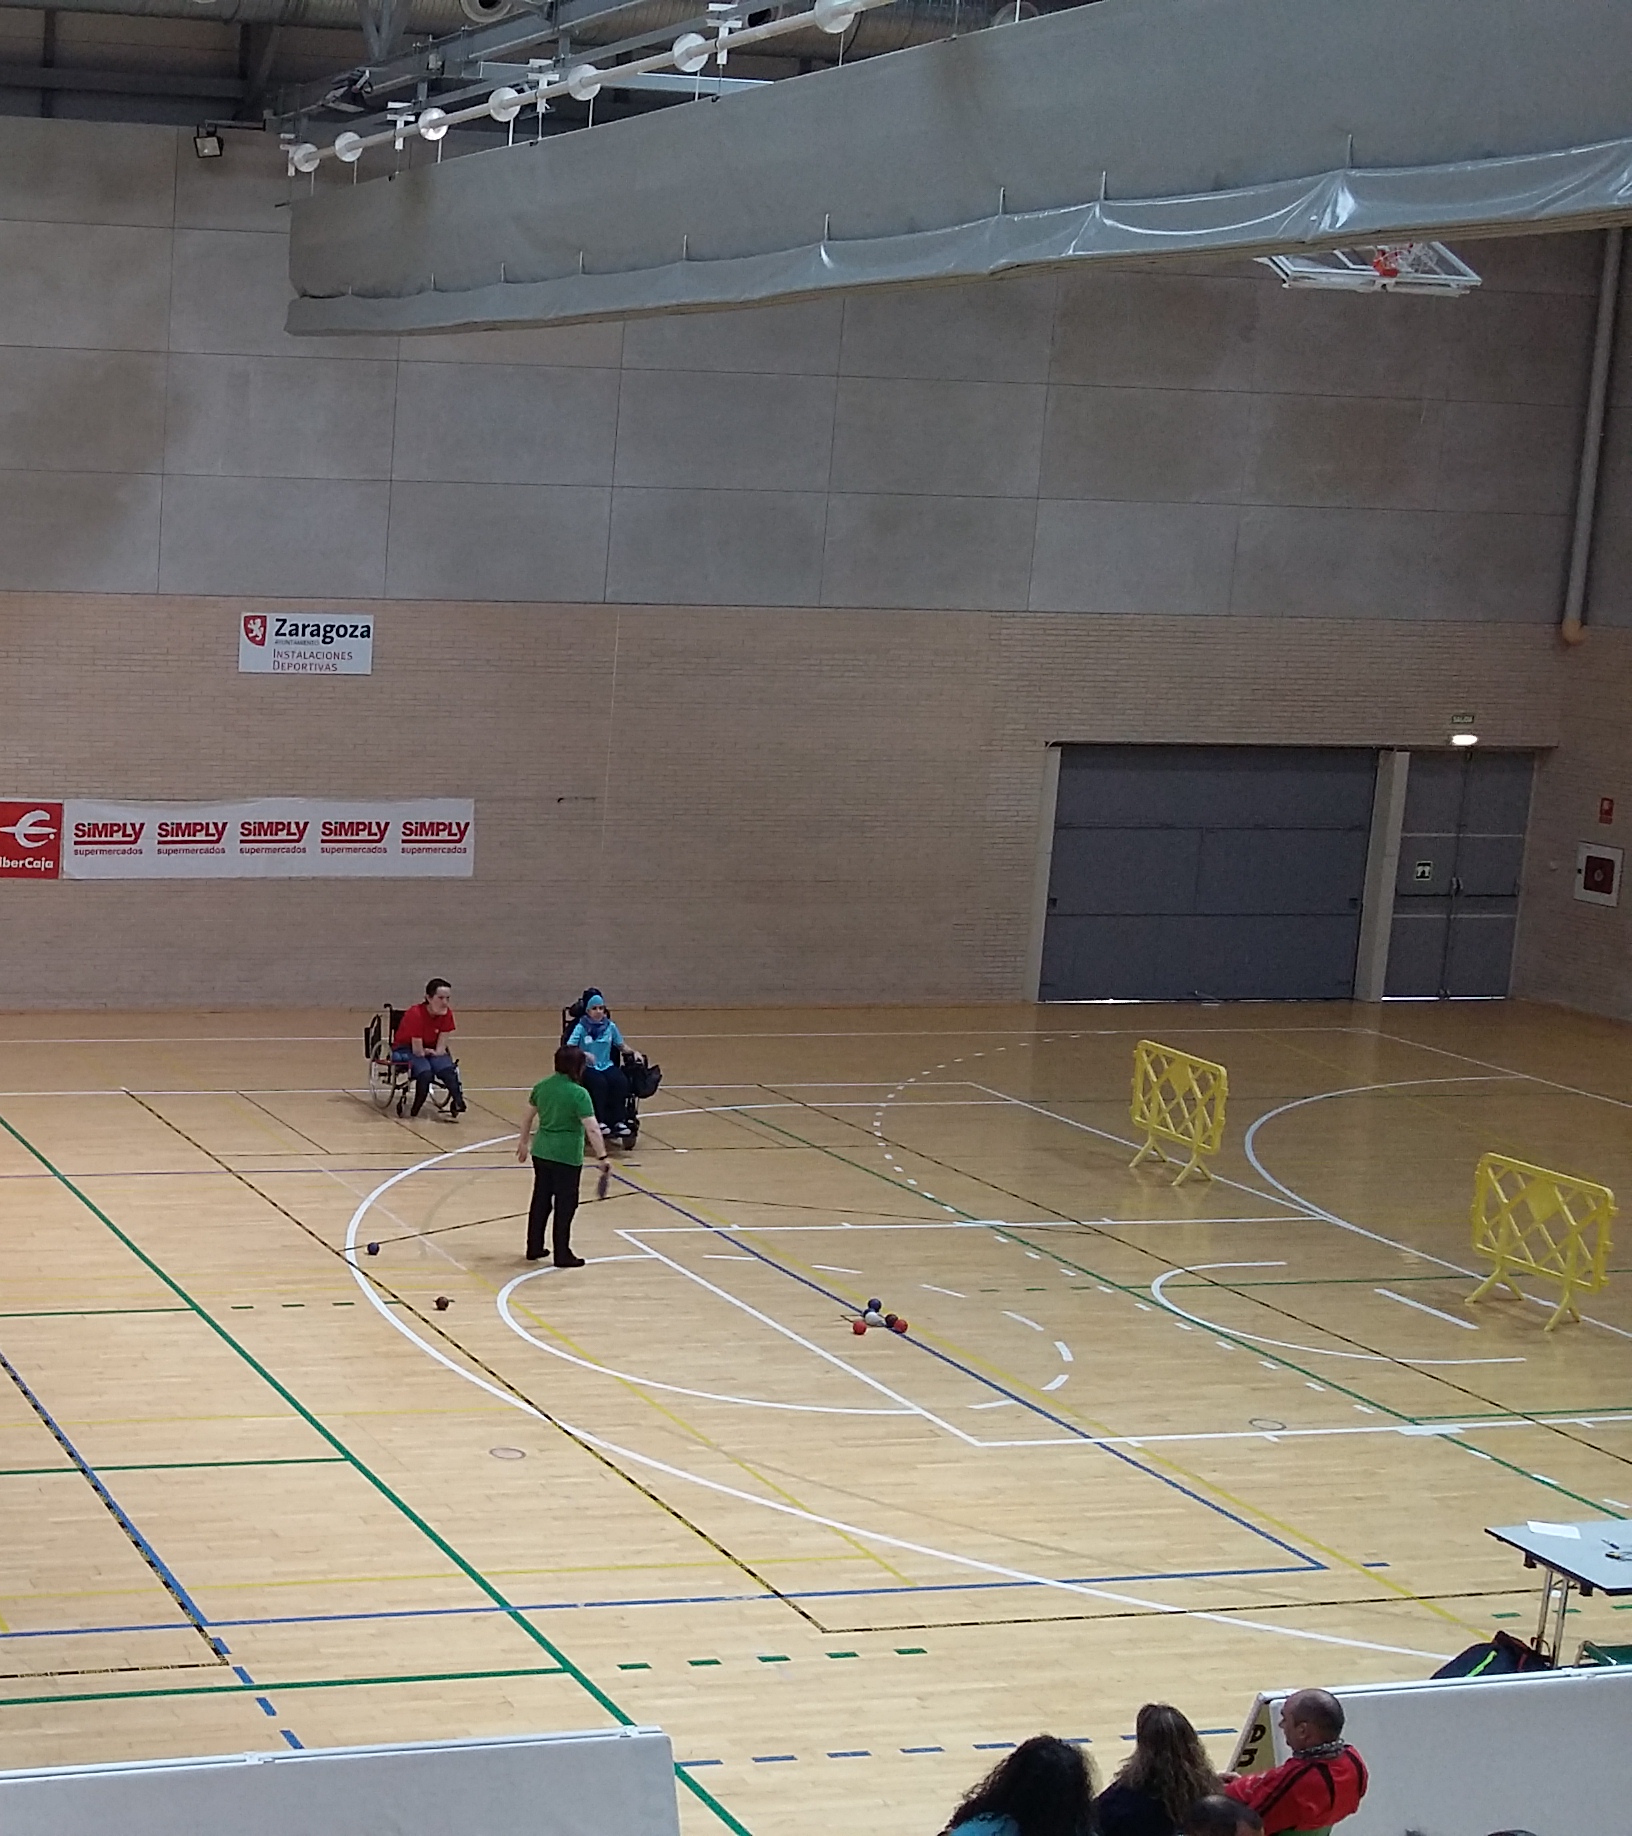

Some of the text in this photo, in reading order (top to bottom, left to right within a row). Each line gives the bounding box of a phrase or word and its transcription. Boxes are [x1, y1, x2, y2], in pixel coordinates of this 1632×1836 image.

[275, 618, 371, 645] Zaragoza
[273, 649, 353, 660] INSTALACIONES
[273, 660, 338, 671] DEPORTIVAS
[74, 847, 143, 857] supermercados
[157, 846, 226, 856] supermercados
[240, 846, 306, 856] supermercados
[320, 846, 387, 855] supermercados
[401, 846, 467, 855] supermercados
